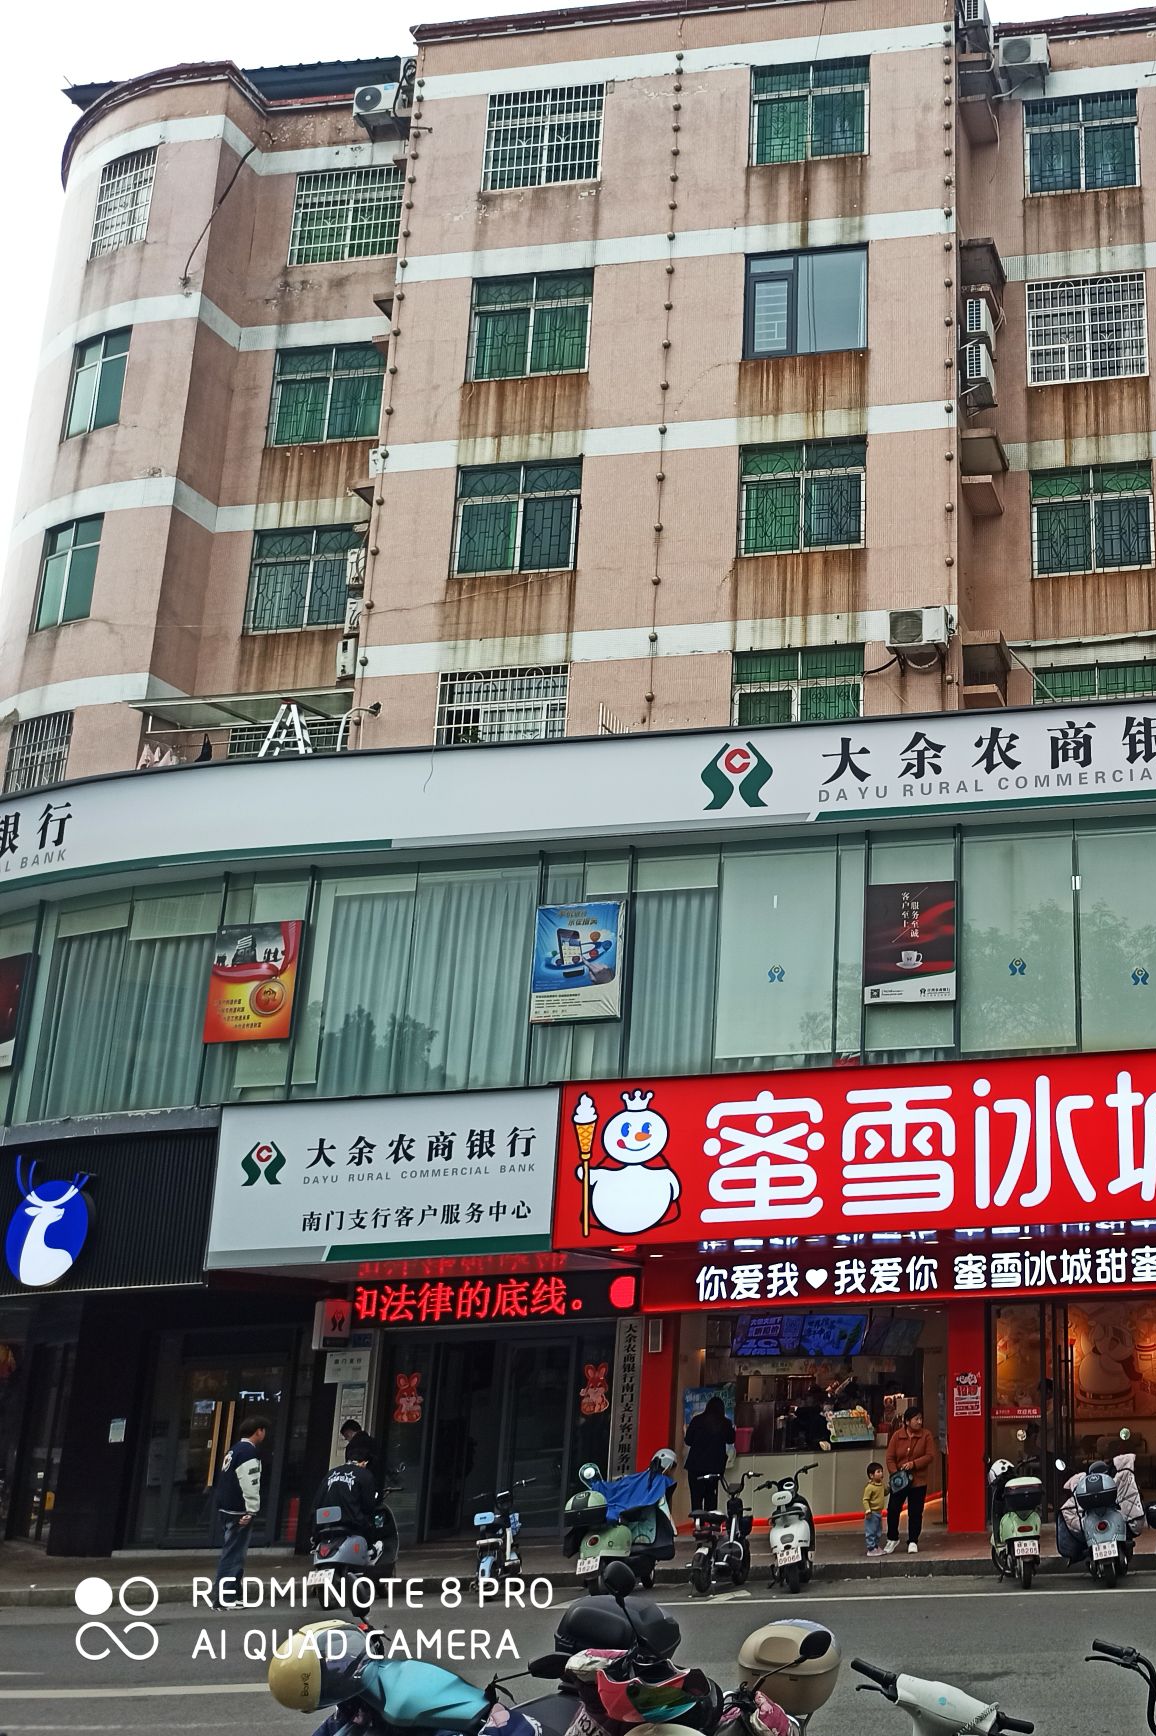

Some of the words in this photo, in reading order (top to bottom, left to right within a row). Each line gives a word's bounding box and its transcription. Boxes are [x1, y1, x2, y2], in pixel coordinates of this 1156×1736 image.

[818, 784, 888, 803] DAYU
[902, 778, 984, 797] RURAL
[20, 849, 66, 869] BANK
[902, 891, 910, 928] 客户至上
[910, 901, 920, 938] 服务至诚
[305, 1126, 537, 1169] 大余农商银行
[303, 1174, 339, 1185] DAYU
[347, 1172, 392, 1183] RURAL
[400, 1165, 490, 1179] COMMERCIAL
[499, 1163, 536, 1173] BANK
[301, 1200, 532, 1232] 南门支行客户服务中心
[696, 1262, 799, 1301] 你爱我
[833, 1254, 940, 1295] 我爱你
[617, 1323, 638, 1479] 大余农商银行南门支行客户服务中
